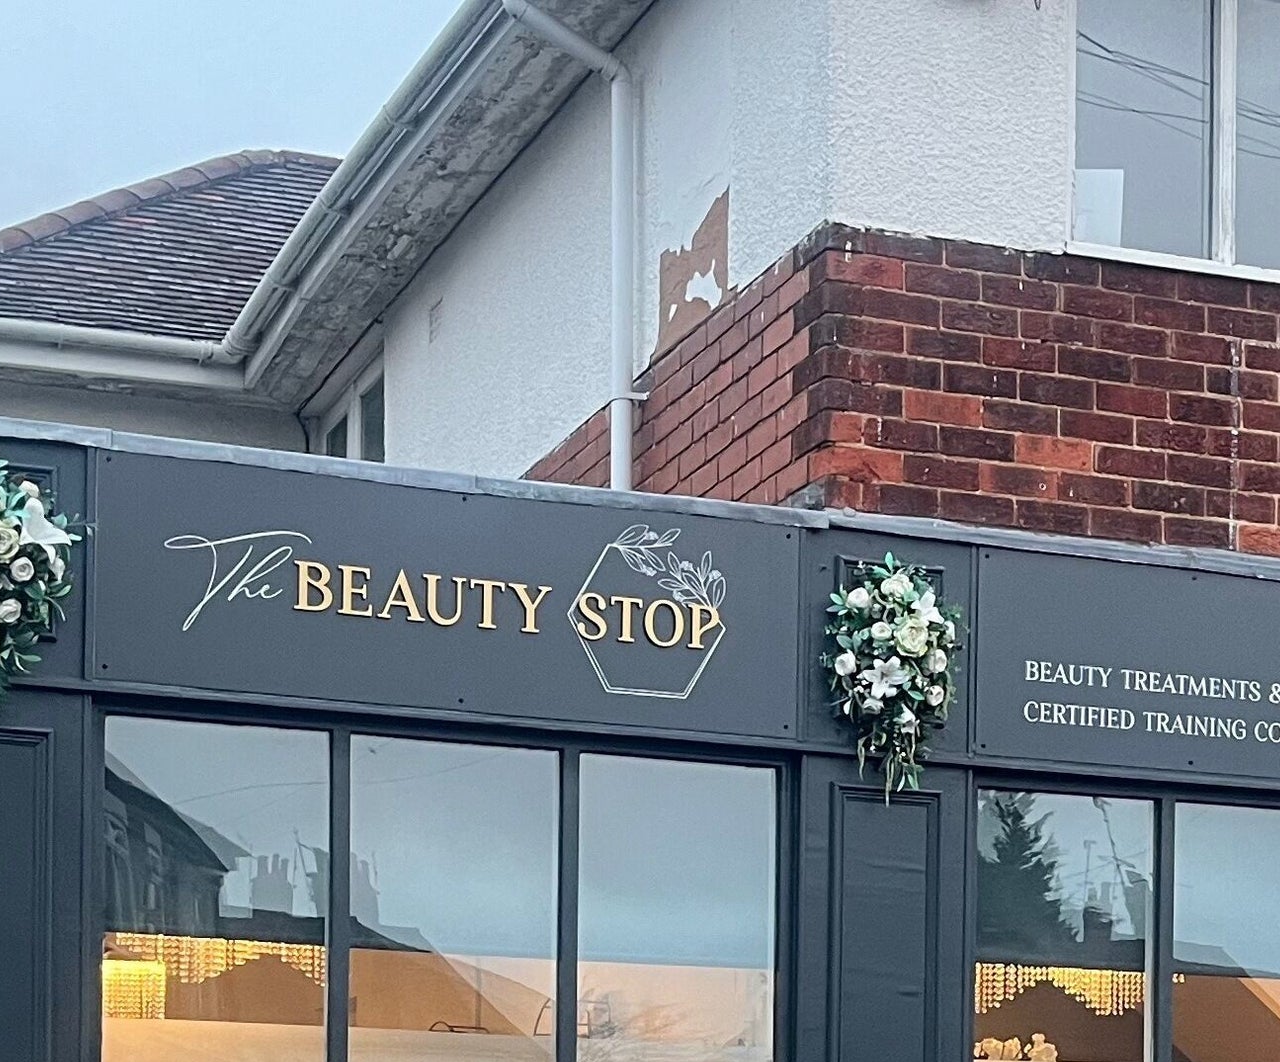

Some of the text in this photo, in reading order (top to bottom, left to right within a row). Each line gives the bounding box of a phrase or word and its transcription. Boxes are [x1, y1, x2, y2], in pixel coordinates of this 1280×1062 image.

[163, 530, 720, 649] The BEAUTY STOP
[1024, 660, 1112, 688] BEAUTY
[1120, 668, 1261, 702] TREATMENTS
[1023, 700, 1135, 730] CERTIFIED
[1143, 711, 1247, 740] TRAINING
